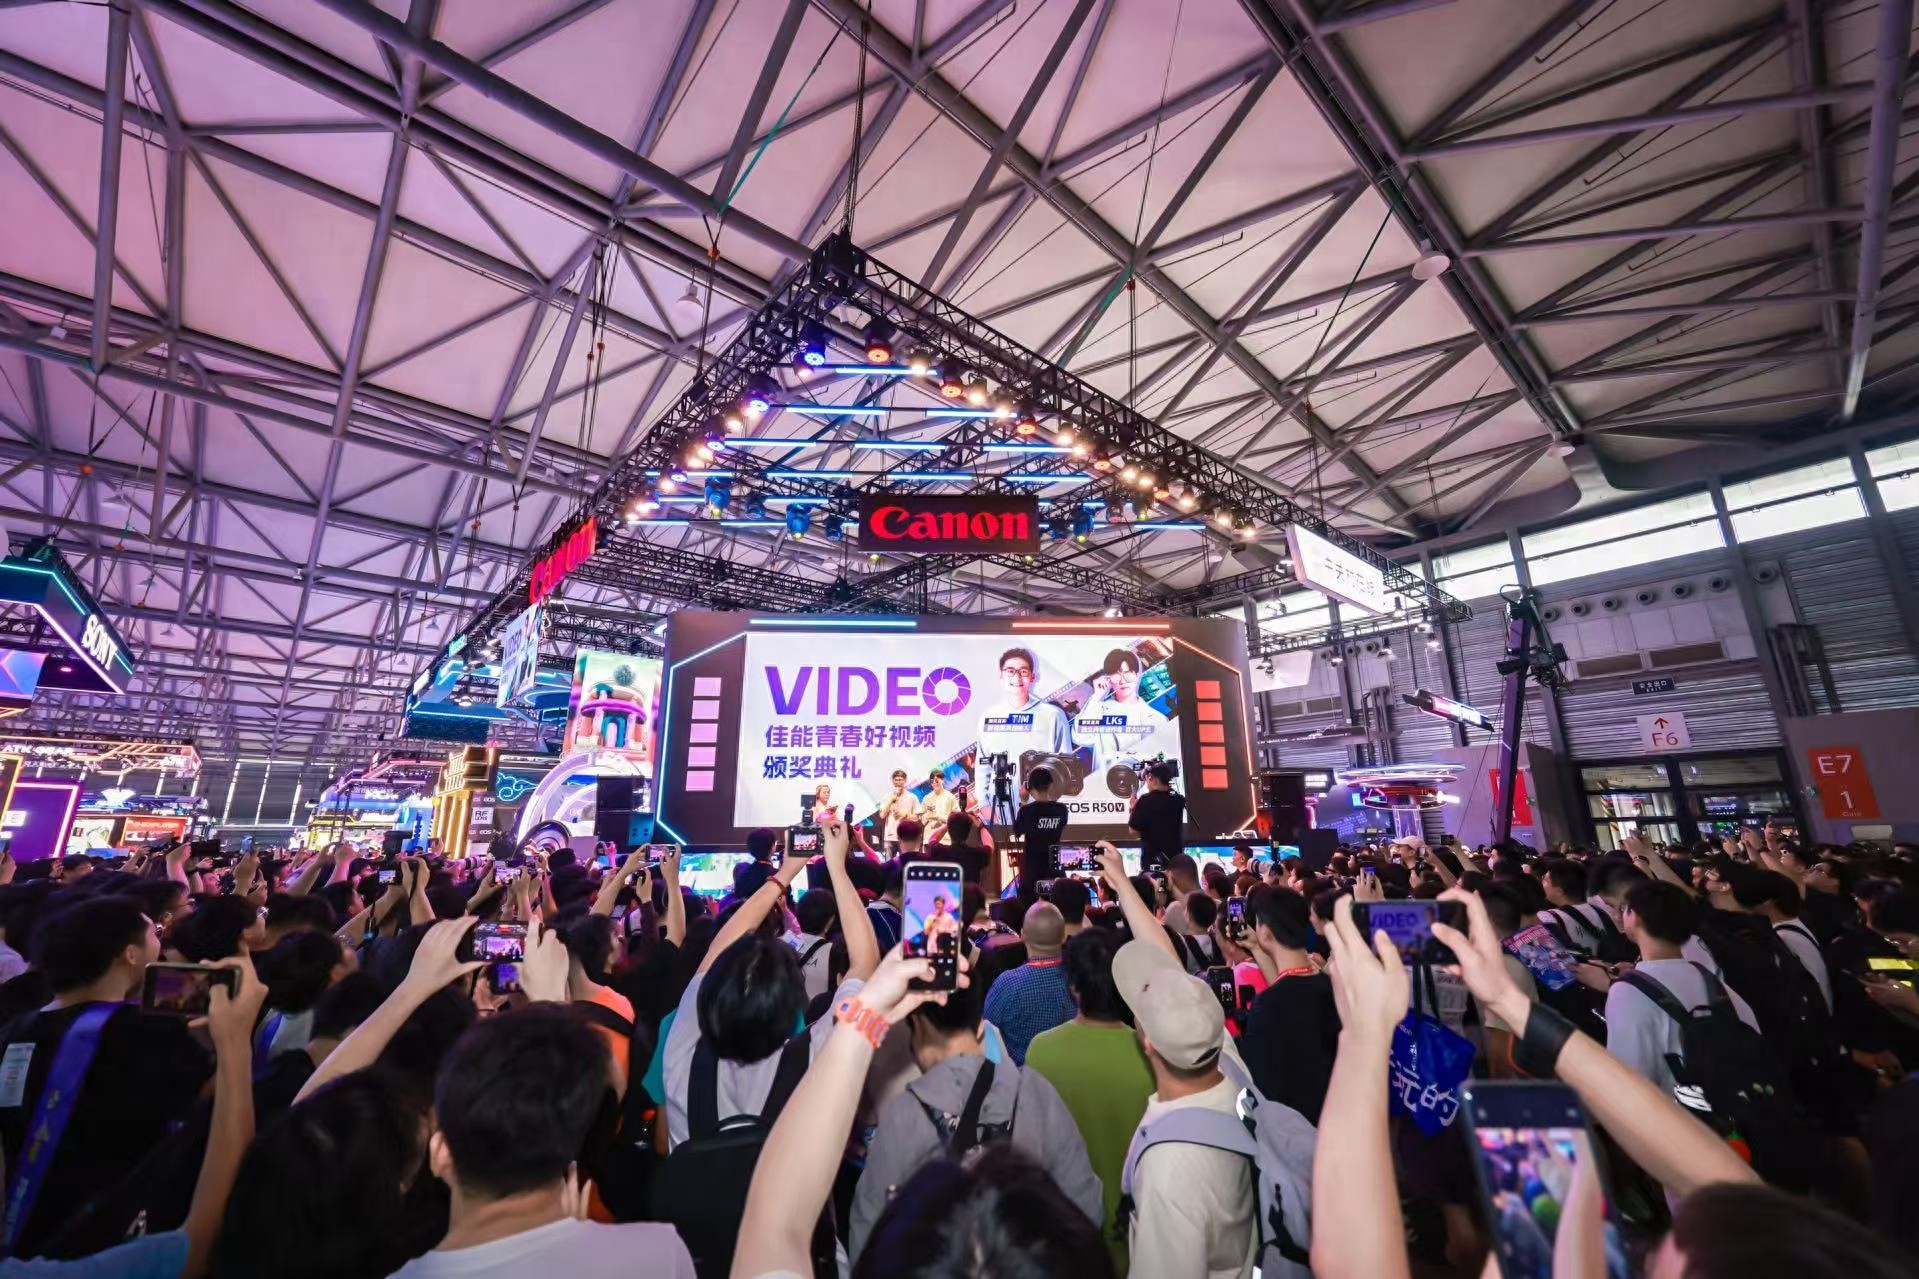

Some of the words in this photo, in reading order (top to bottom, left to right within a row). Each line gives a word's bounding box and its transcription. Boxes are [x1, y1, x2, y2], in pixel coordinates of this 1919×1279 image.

[870, 506, 1029, 540] Canon
[81, 614, 118, 671] SONY
[764, 665, 972, 716] VIDEO
[1012, 715, 1030, 724] TIM
[1106, 716, 1123, 725] LKs
[765, 725, 936, 748] 佳能青春好视频
[763, 756, 862, 779] 颁奖典礼
[1817, 754, 1852, 774] E7
[1840, 790, 1853, 809] 1
[1038, 817, 1060, 829] STAFF
[1369, 912, 1419, 930] VIDEO
[1389, 1050, 1459, 1127] 玩的
